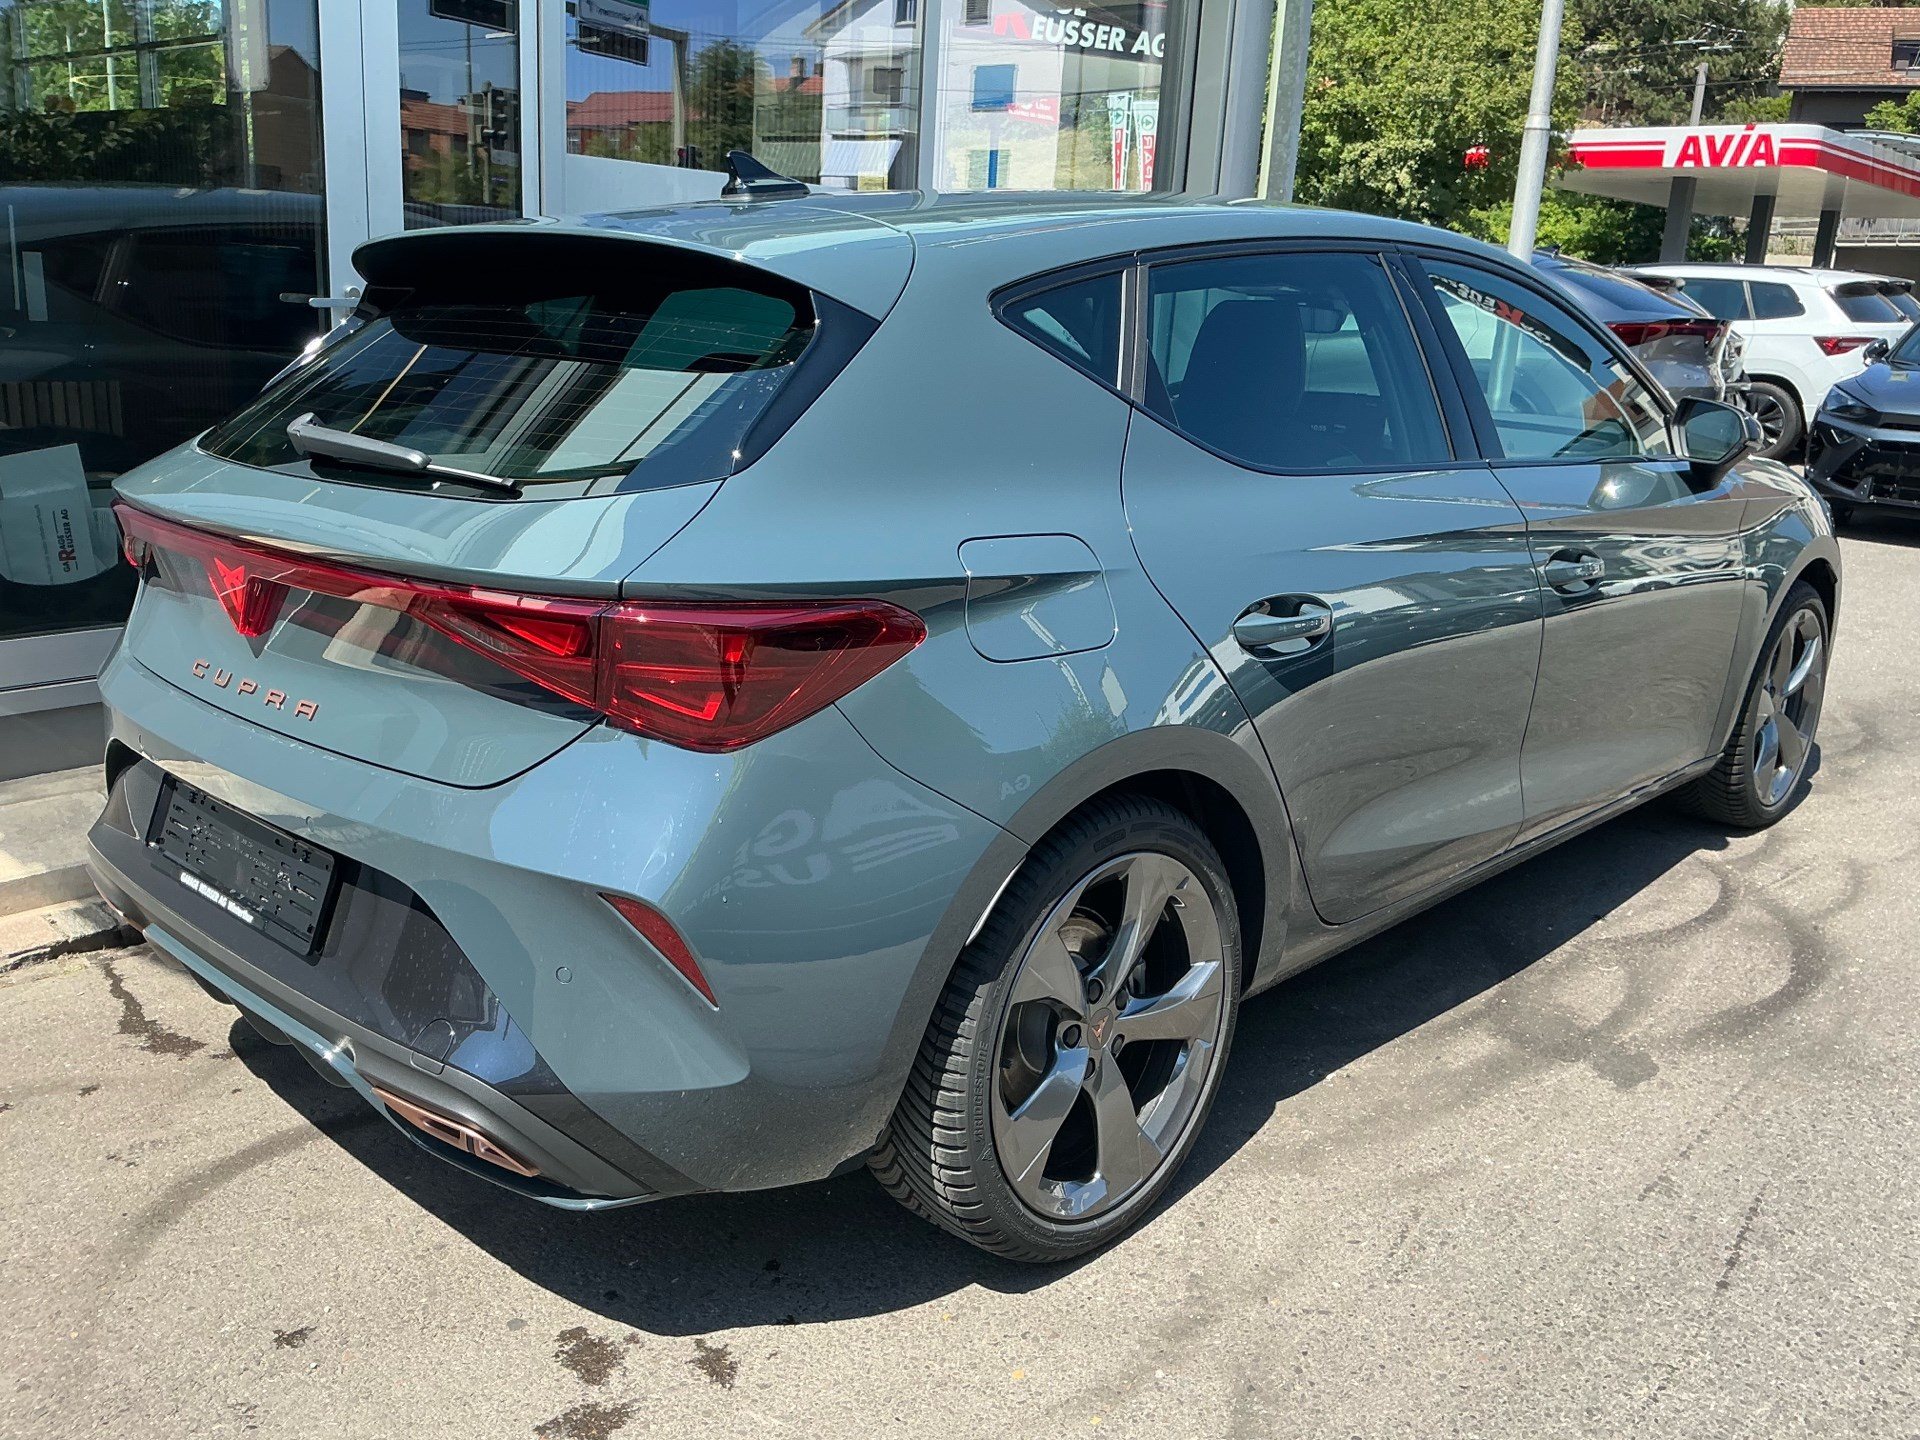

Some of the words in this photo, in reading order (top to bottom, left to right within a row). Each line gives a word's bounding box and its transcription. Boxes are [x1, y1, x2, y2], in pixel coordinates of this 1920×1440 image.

[1674, 123, 1777, 168] AVIA
[60, 508, 70, 520] AG
[192, 659, 319, 722] CUPRA
